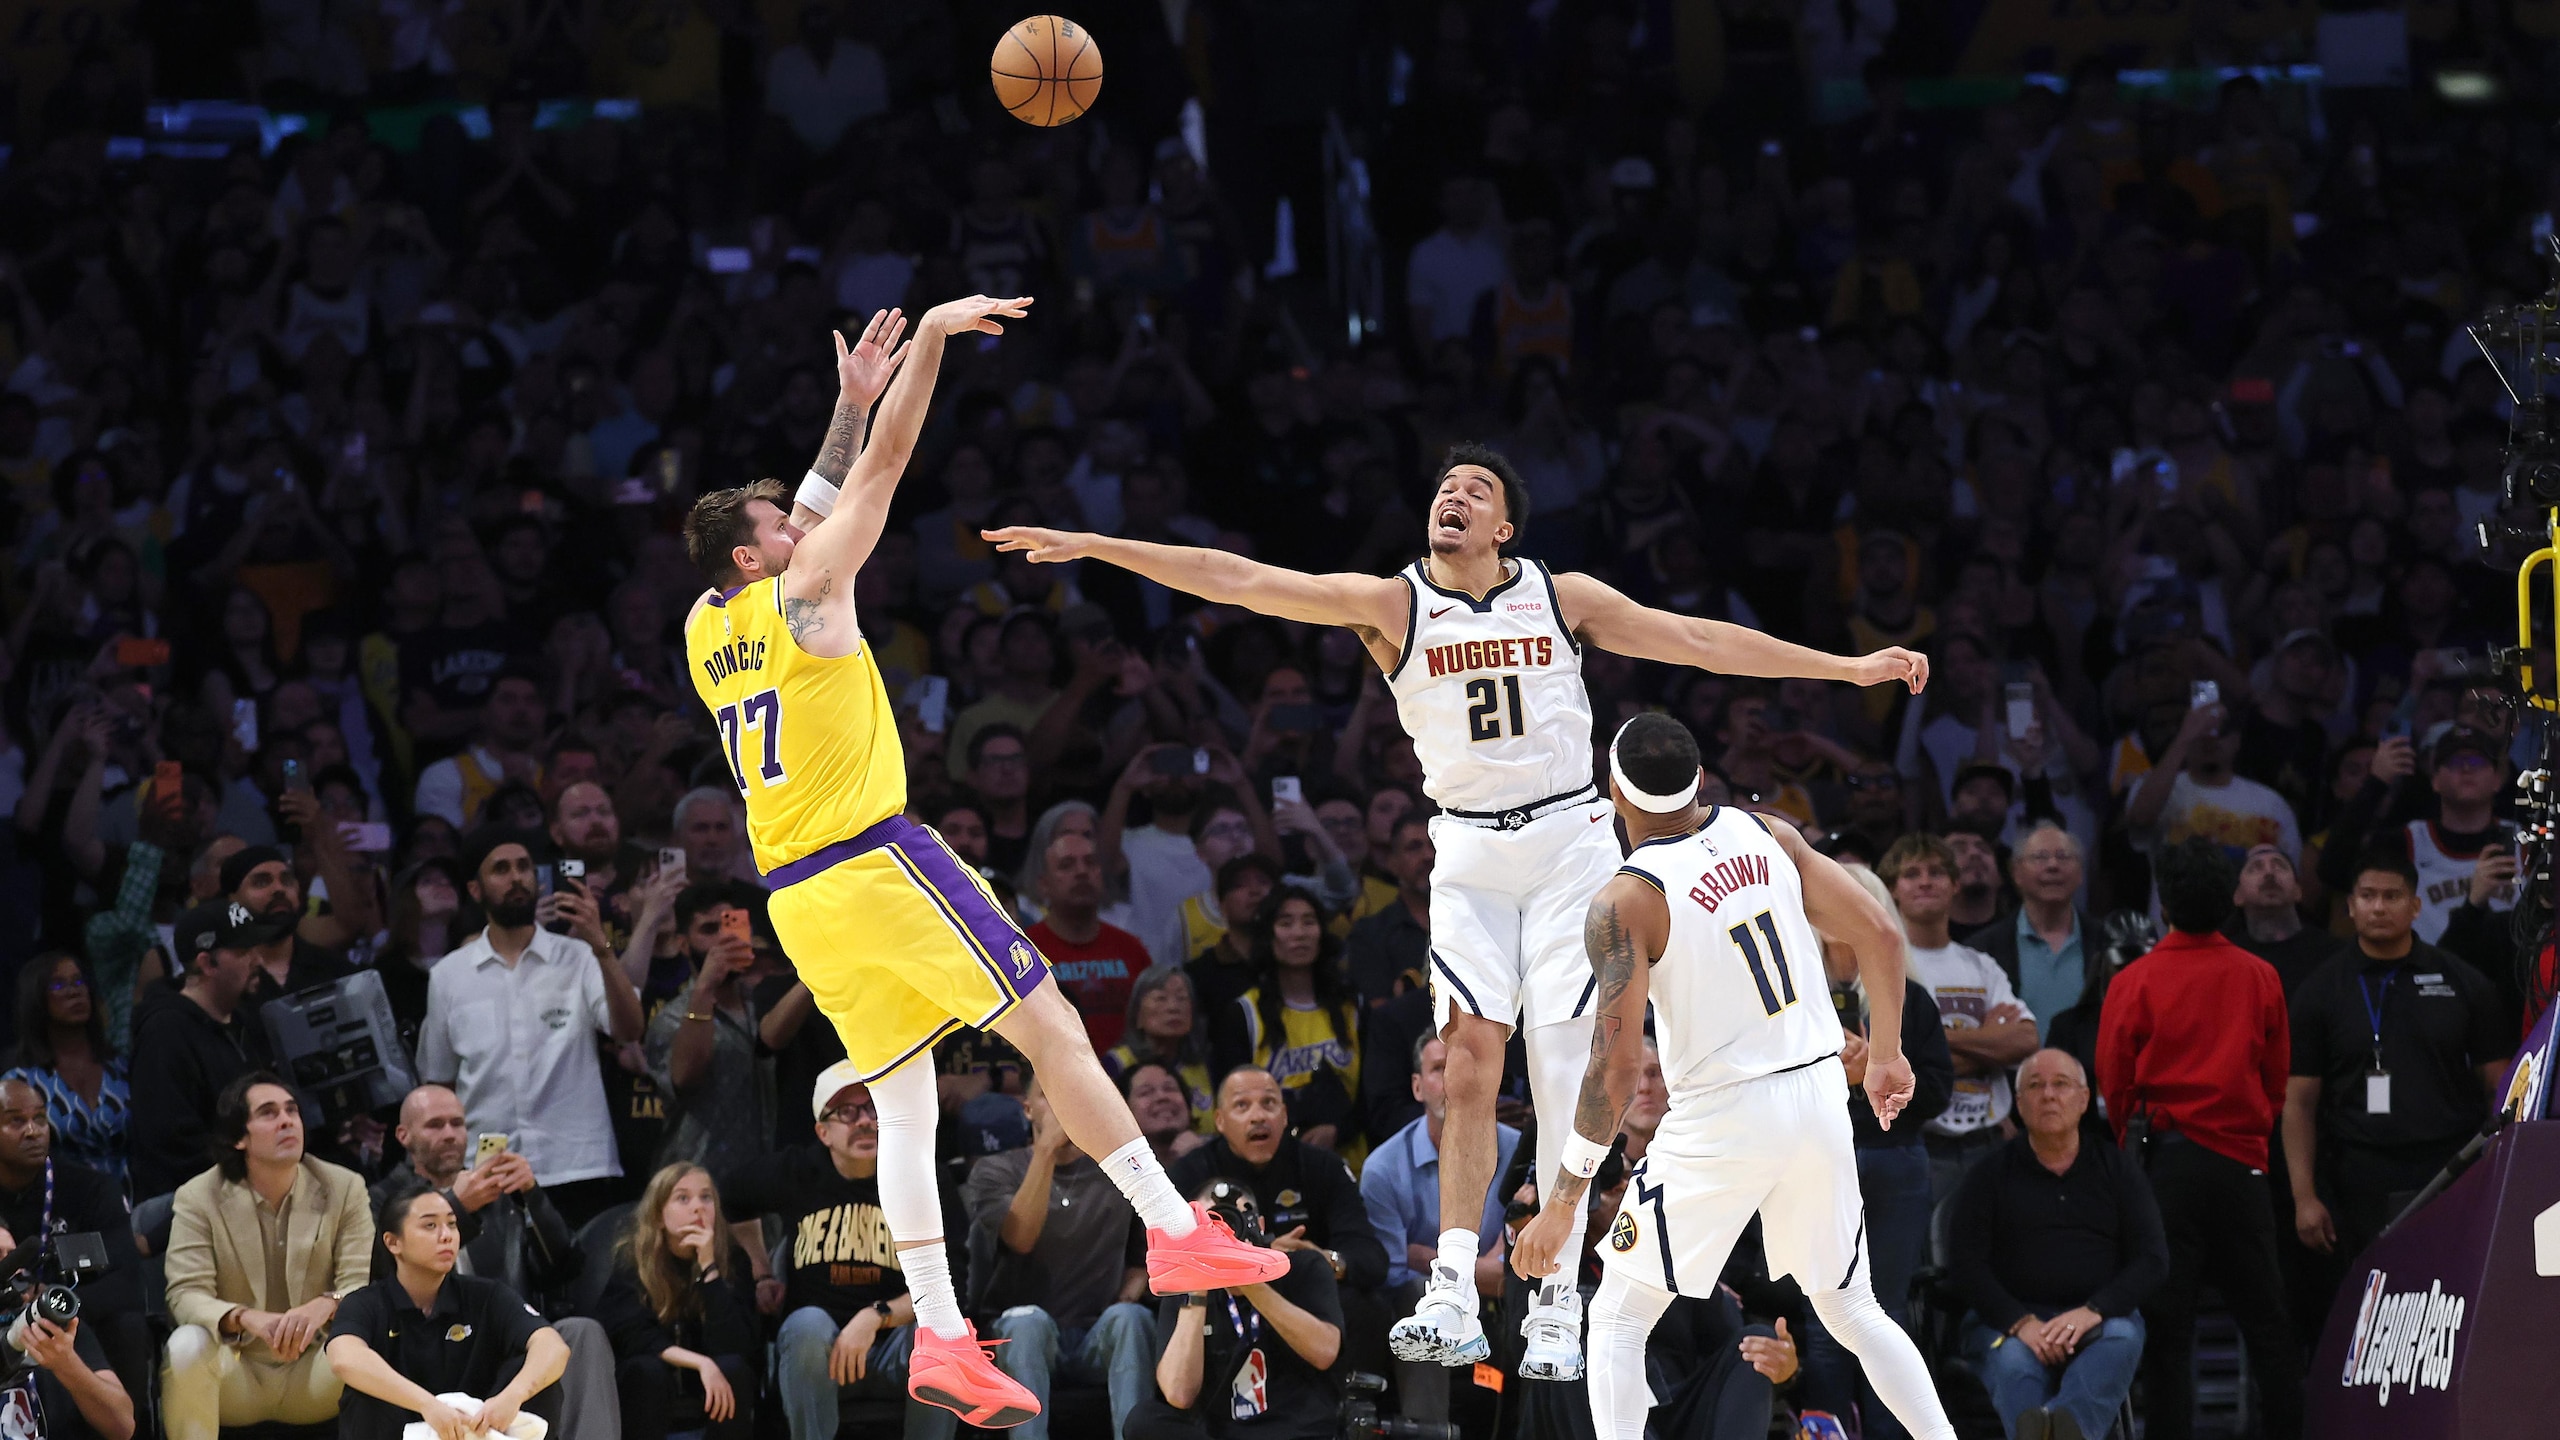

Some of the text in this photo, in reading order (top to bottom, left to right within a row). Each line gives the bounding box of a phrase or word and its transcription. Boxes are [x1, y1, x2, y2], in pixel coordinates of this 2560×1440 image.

[1506, 602, 1542, 612] ibotta
[703, 634, 766, 687] DONČIĆ
[1425, 636, 1552, 677] NUGGETS
[1465, 674, 1525, 742] 21
[716, 688, 786, 793] 77
[1688, 854, 1770, 914] BROWN
[1727, 909, 1798, 1018] 11
[2354, 1271, 2466, 1408] League Pass
